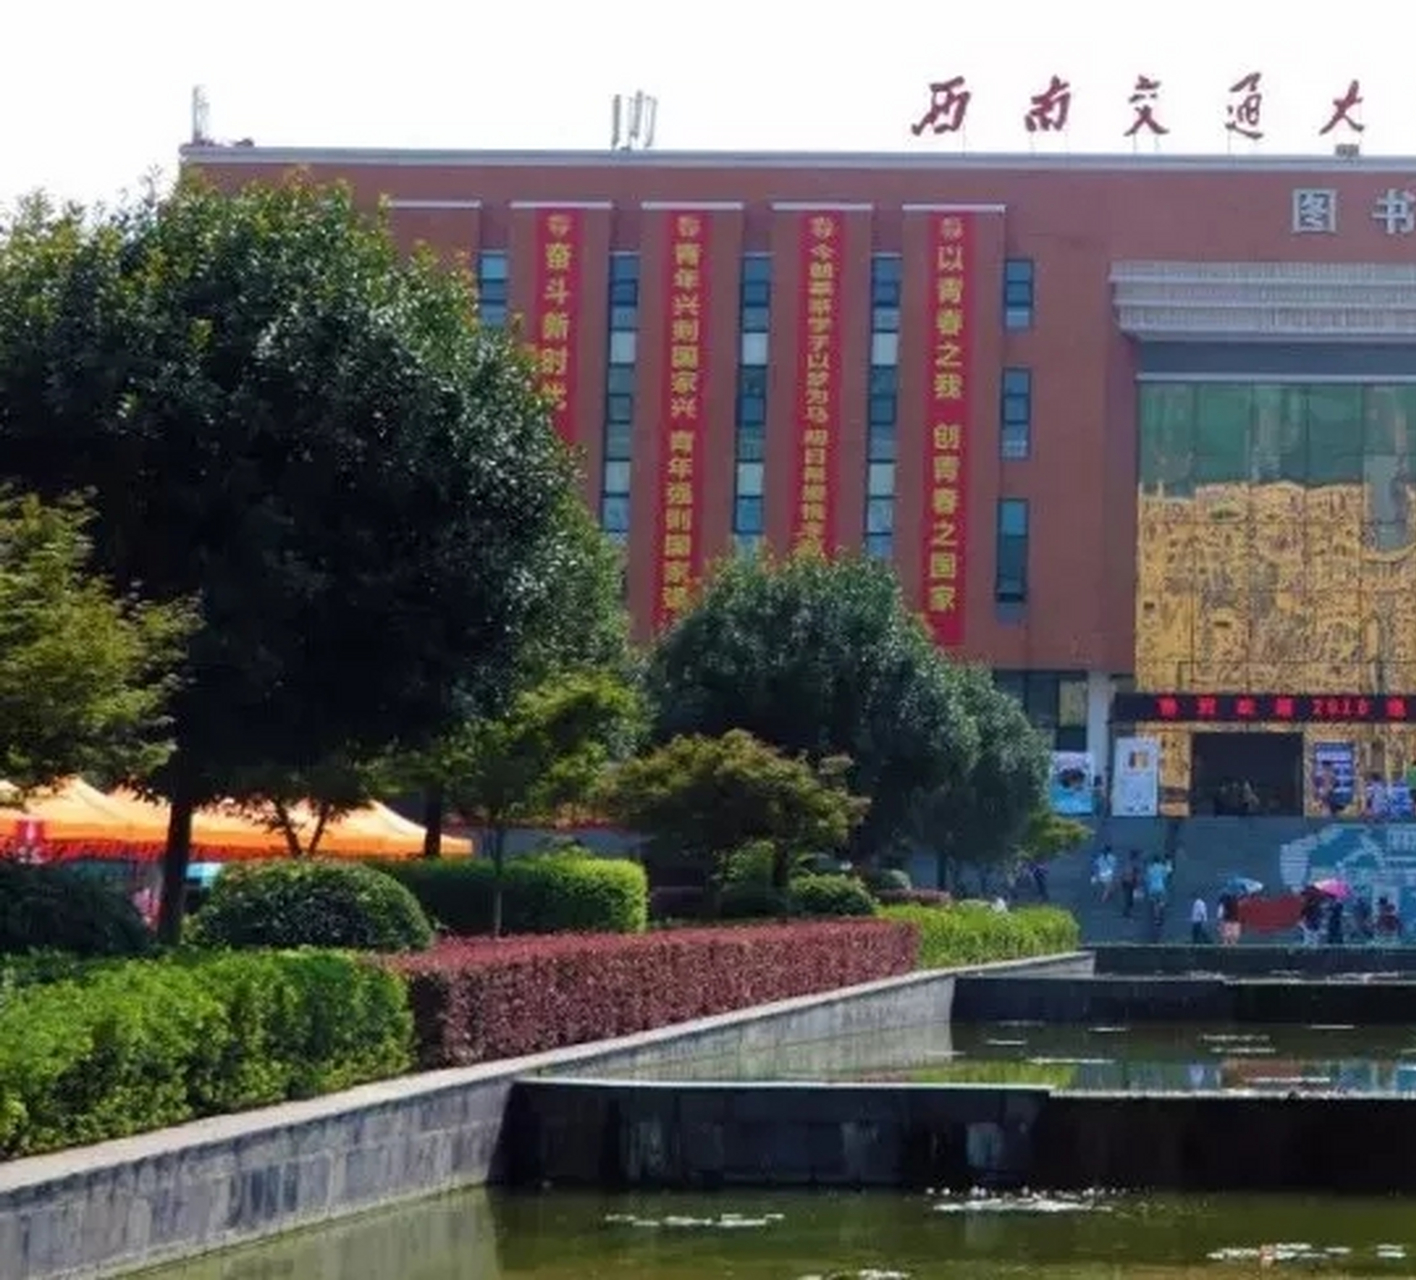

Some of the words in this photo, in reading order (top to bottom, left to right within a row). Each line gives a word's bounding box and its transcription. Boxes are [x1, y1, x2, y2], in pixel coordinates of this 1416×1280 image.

[669, 243, 702, 421] 青年兴则国家兴
[933, 246, 964, 402] 以青春之我
[929, 423, 961, 613] 创青春之国家
